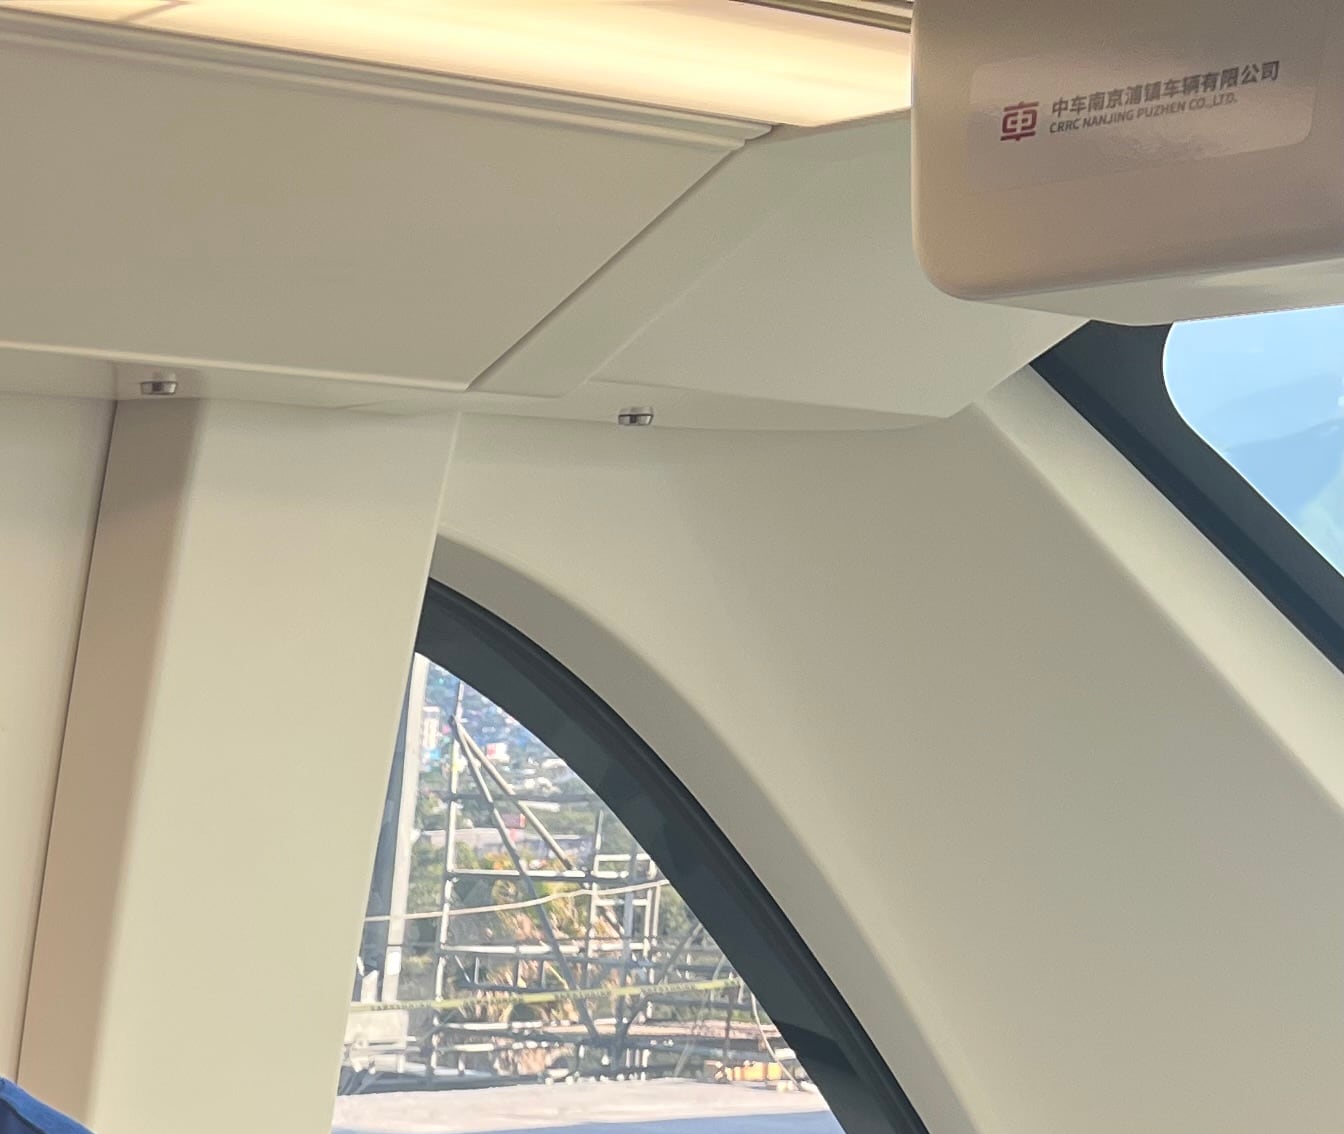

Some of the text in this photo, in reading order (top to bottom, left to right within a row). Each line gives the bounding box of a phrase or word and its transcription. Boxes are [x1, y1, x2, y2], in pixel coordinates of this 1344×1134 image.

[1051, 60, 1280, 118] 中车南京浦镇车辆有限公司
[1049, 119, 1080, 134] CRRC
[1082, 108, 1134, 128] NANJING
[1136, 98, 1186, 121] PUZHEN
